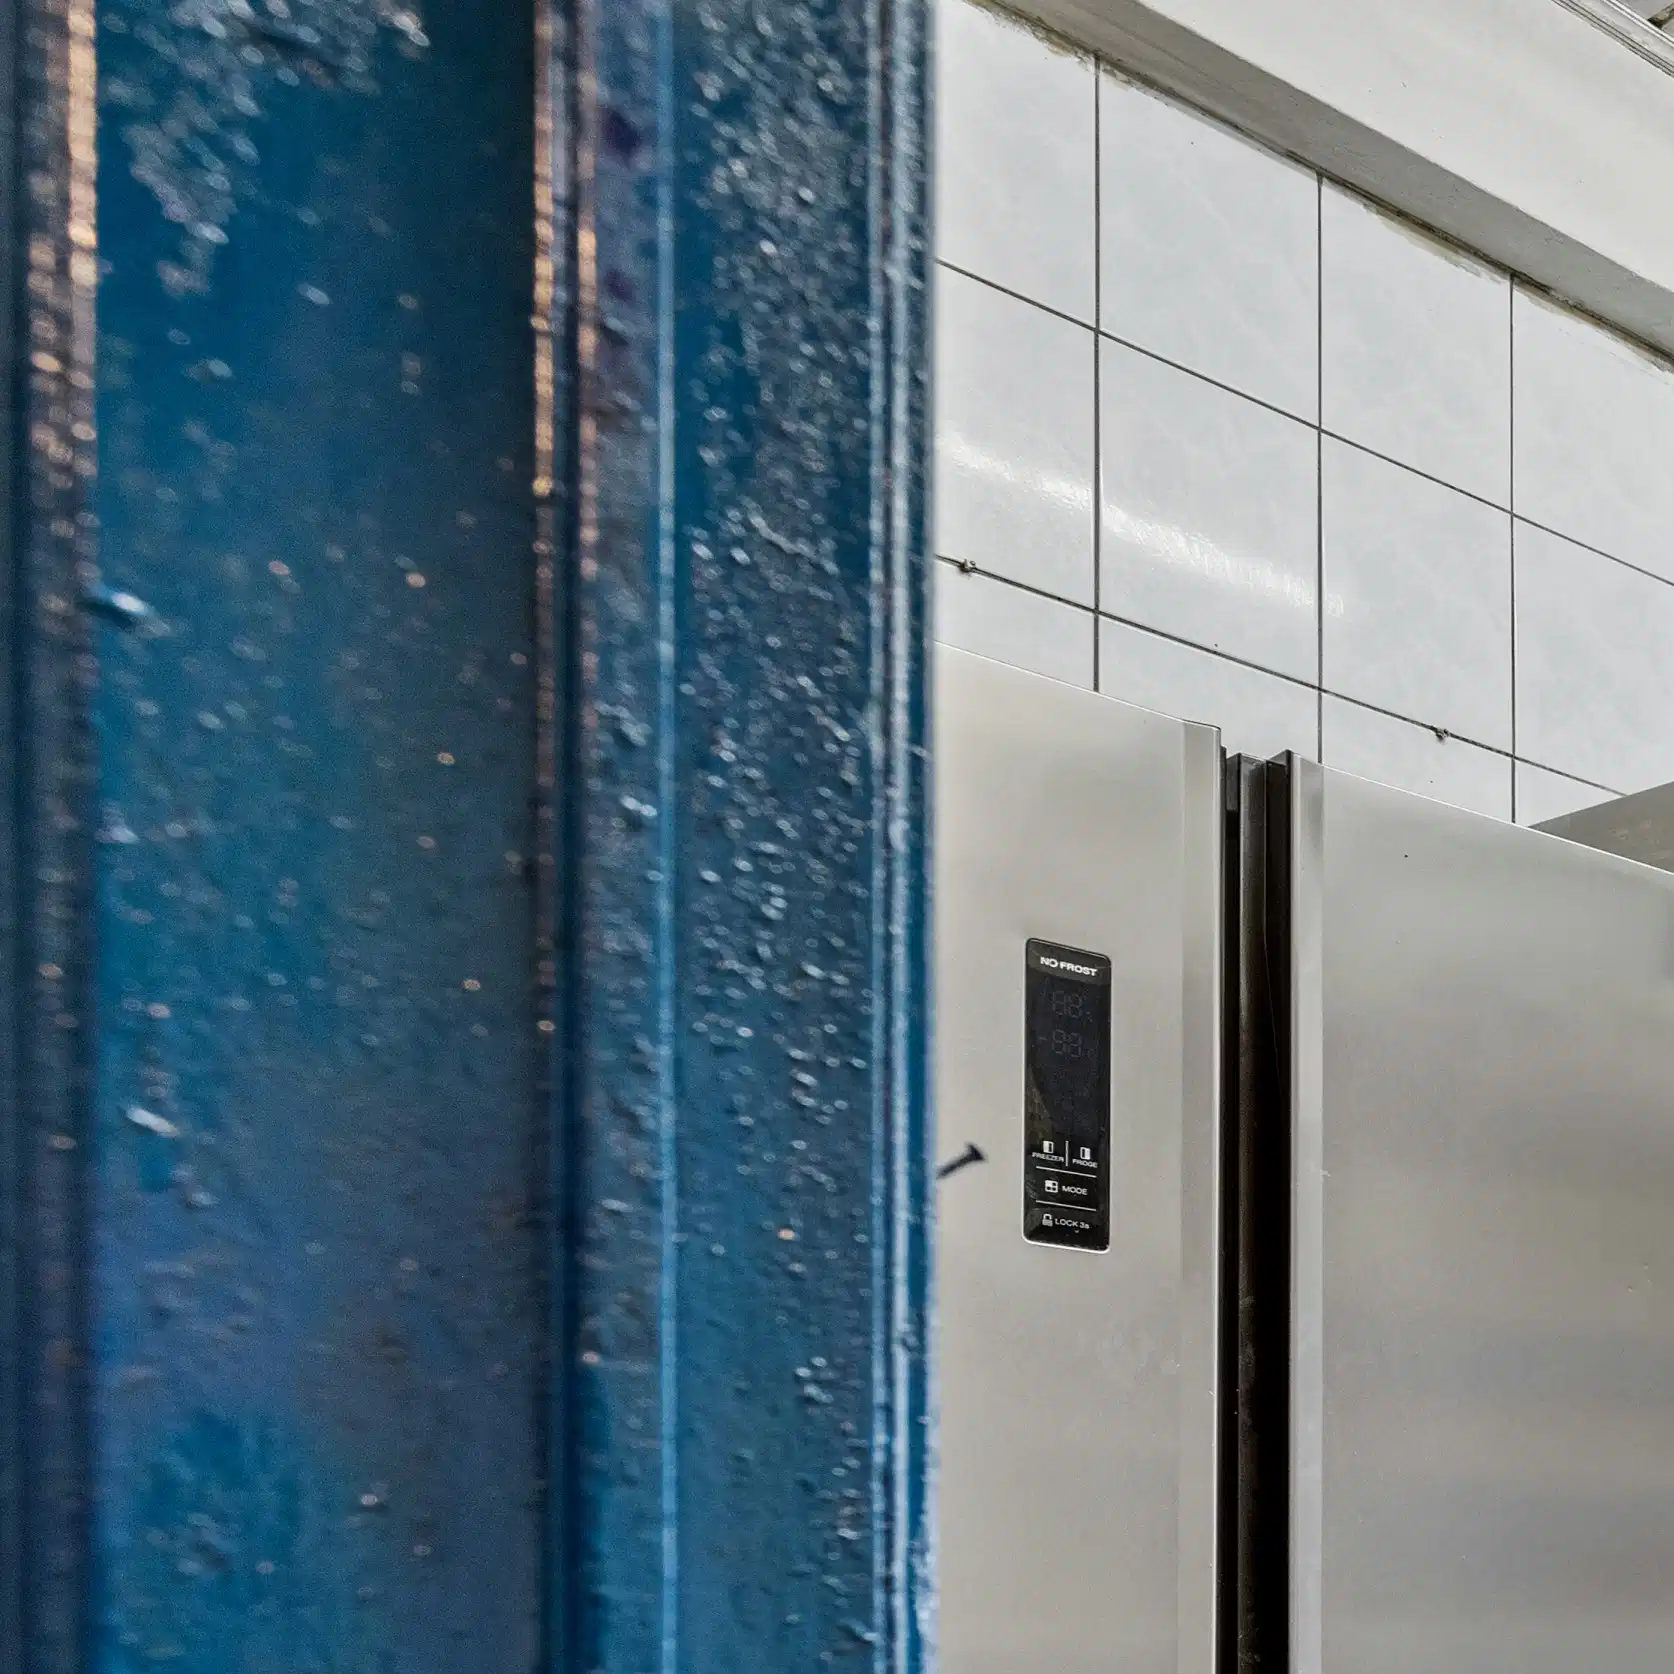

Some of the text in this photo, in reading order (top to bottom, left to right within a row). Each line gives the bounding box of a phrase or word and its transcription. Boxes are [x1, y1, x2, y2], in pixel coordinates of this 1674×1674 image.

[1040, 956, 1098, 977] NO FROST
[1031, 1152, 1065, 1163] FREEZER
[1072, 1158, 1098, 1169] FRIDGE
[1061, 1185, 1089, 1196] MODE
[1054, 1218, 1079, 1228] LOCK
